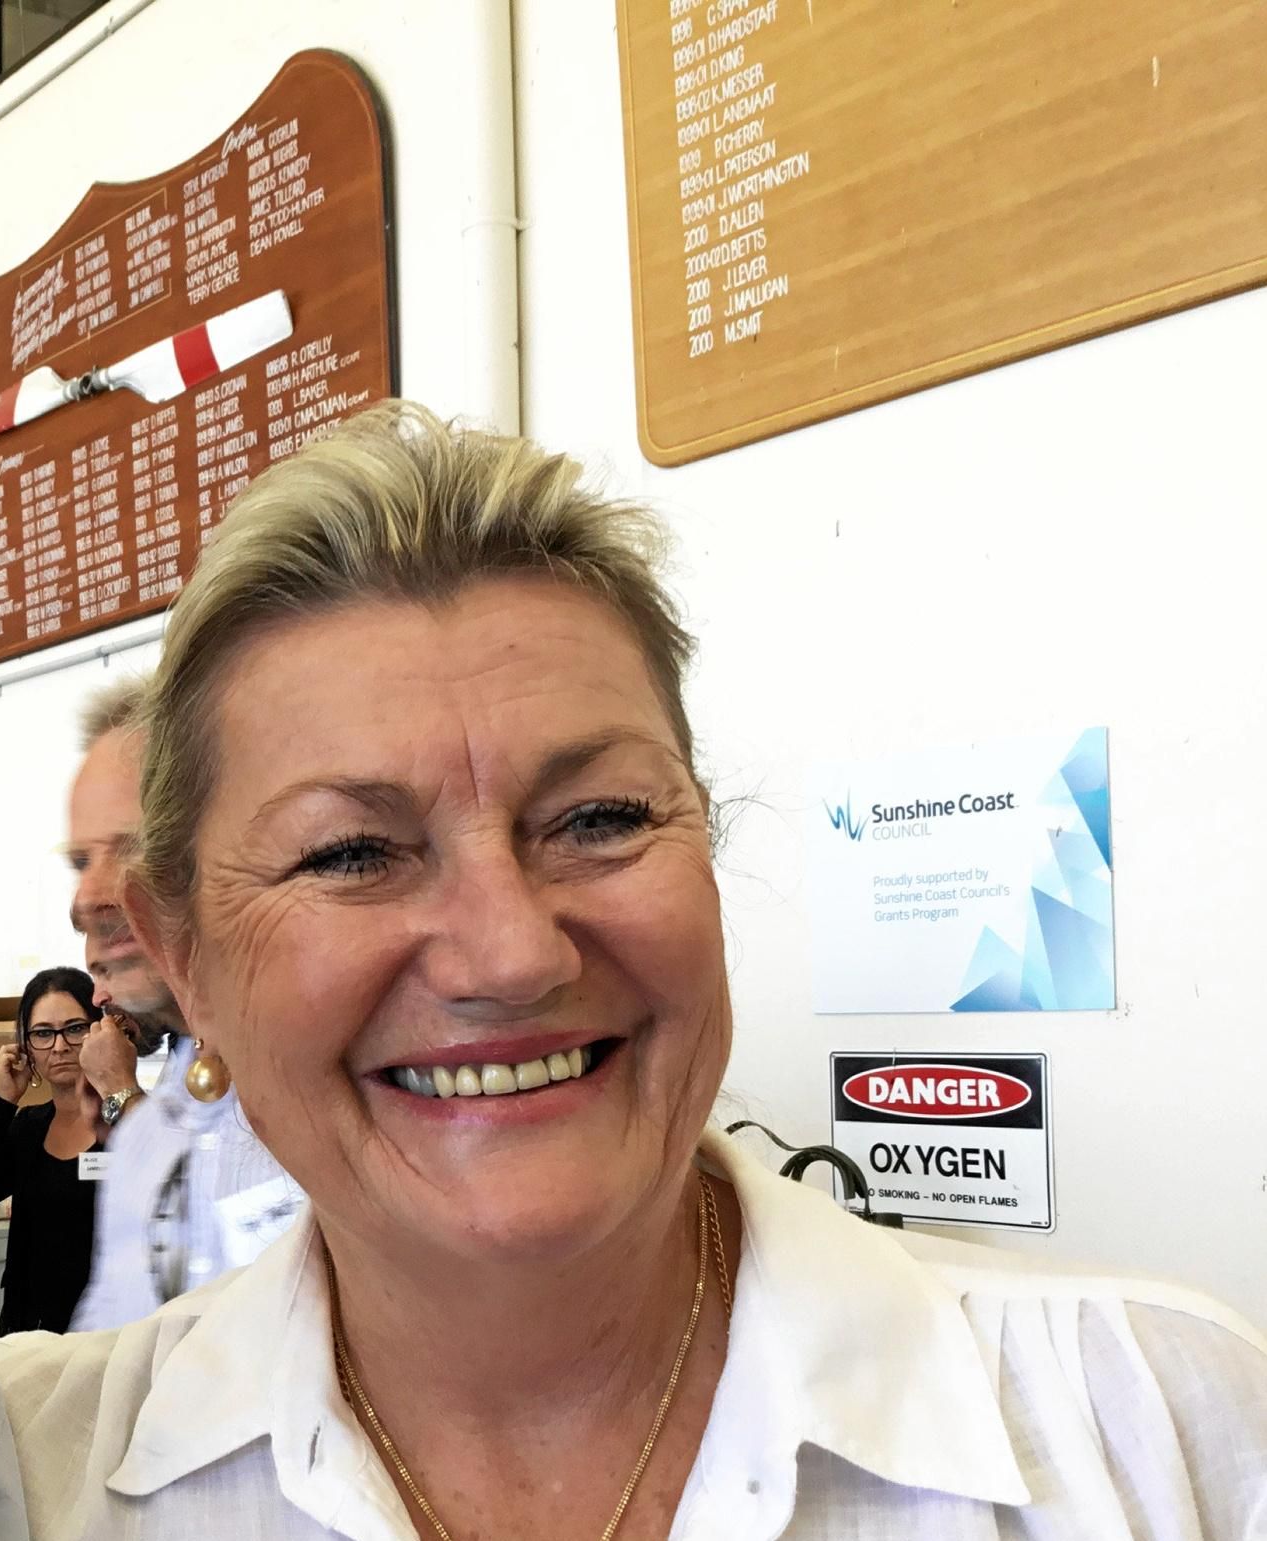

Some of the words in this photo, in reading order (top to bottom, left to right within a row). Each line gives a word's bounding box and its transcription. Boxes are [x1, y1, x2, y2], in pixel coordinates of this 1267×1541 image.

[715, 119, 765, 158] P.CHERRY
[716, 140, 775, 184] L.PATERSON
[717, 152, 809, 209] J.WORTHINGTON
[684, 224, 708, 252] 2000
[687, 278, 710, 304] 2000
[723, 256, 767, 291] J.LEVER
[689, 304, 711, 331] 2000
[690, 331, 713, 357] 2000
[872, 800, 955, 824] Sunshine
[959, 792, 1014, 814] Coast
[872, 823, 931, 841] COUNCIL
[873, 873, 913, 889] Proudly
[915, 869, 972, 886] supported
[975, 868, 989, 883] by
[874, 889, 923, 905] Sunshine
[925, 888, 957, 902] Coast
[960, 884, 1010, 900] Council's
[874, 908, 910, 922] Grants
[913, 906, 959, 922] Program
[868, 1076, 1000, 1107] DANGER
[869, 1143, 1006, 1180] OXYGEN
[879, 1189, 920, 1200] SMOKING
[932, 1193, 946, 1202] NO
[950, 1194, 975, 1204] OPEN
[979, 1193, 1018, 1207] FLAMES
